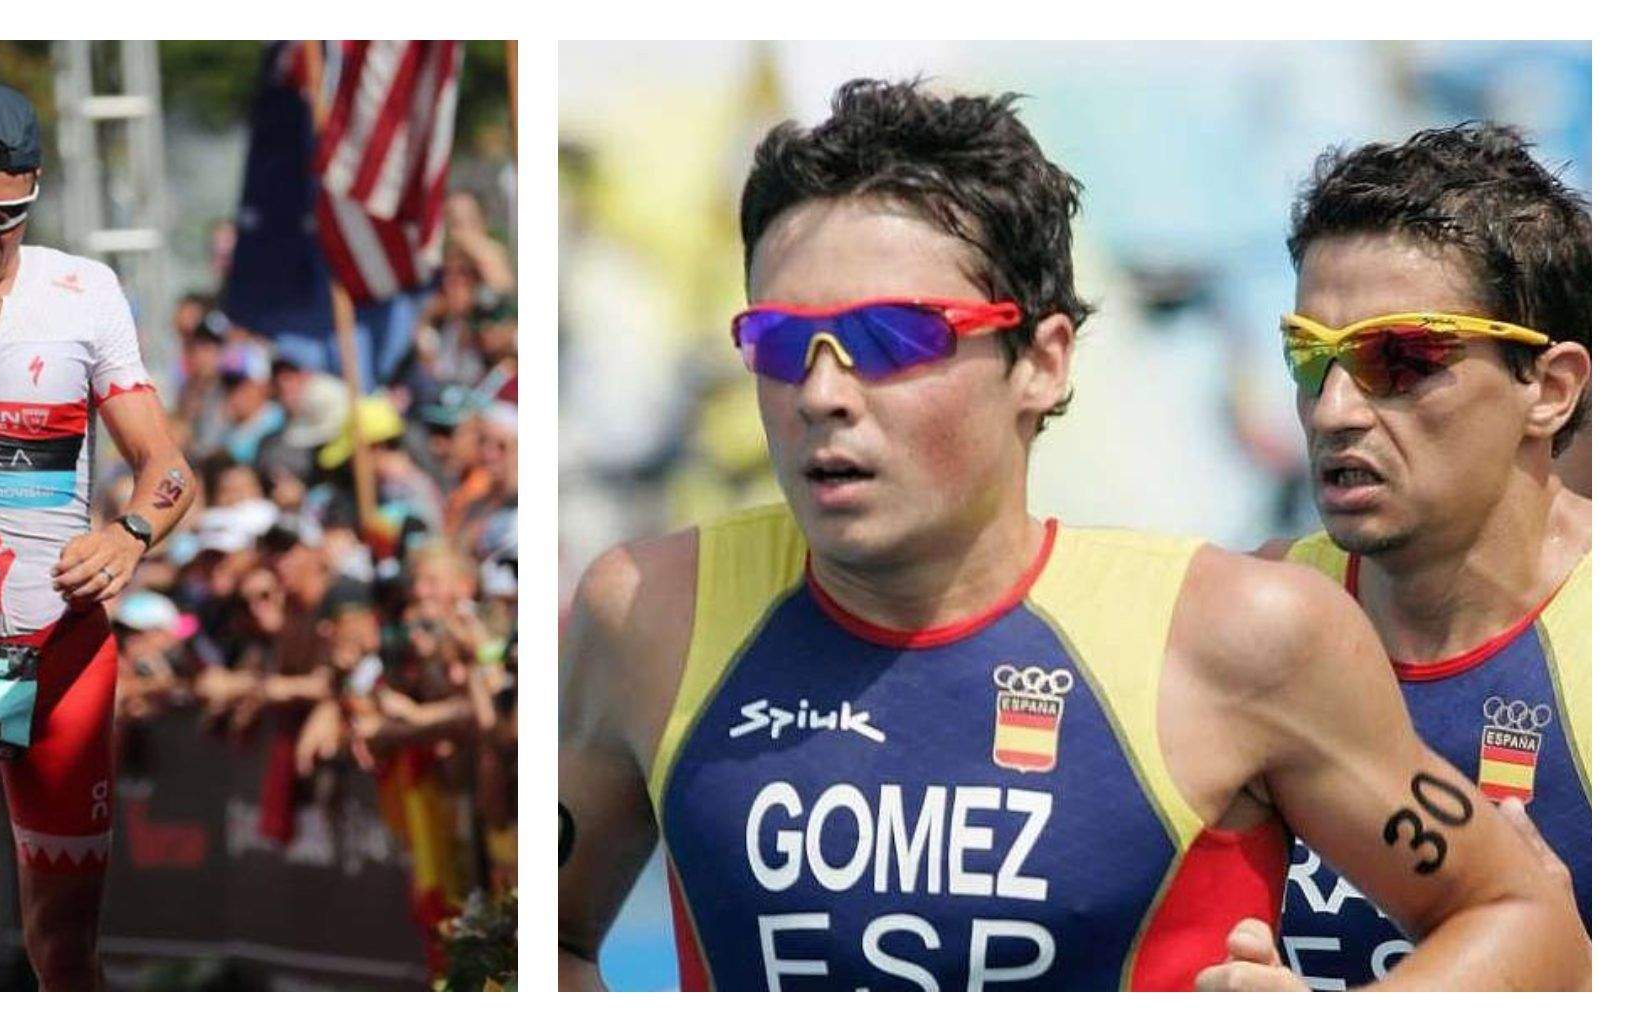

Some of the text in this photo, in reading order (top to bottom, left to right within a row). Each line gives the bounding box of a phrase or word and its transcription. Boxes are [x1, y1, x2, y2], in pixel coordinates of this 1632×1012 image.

[729, 699, 886, 743] Spiuk
[745, 780, 1054, 900] GOMEZ
[1383, 772, 1473, 875] 30
[758, 912, 1056, 991] ESP
